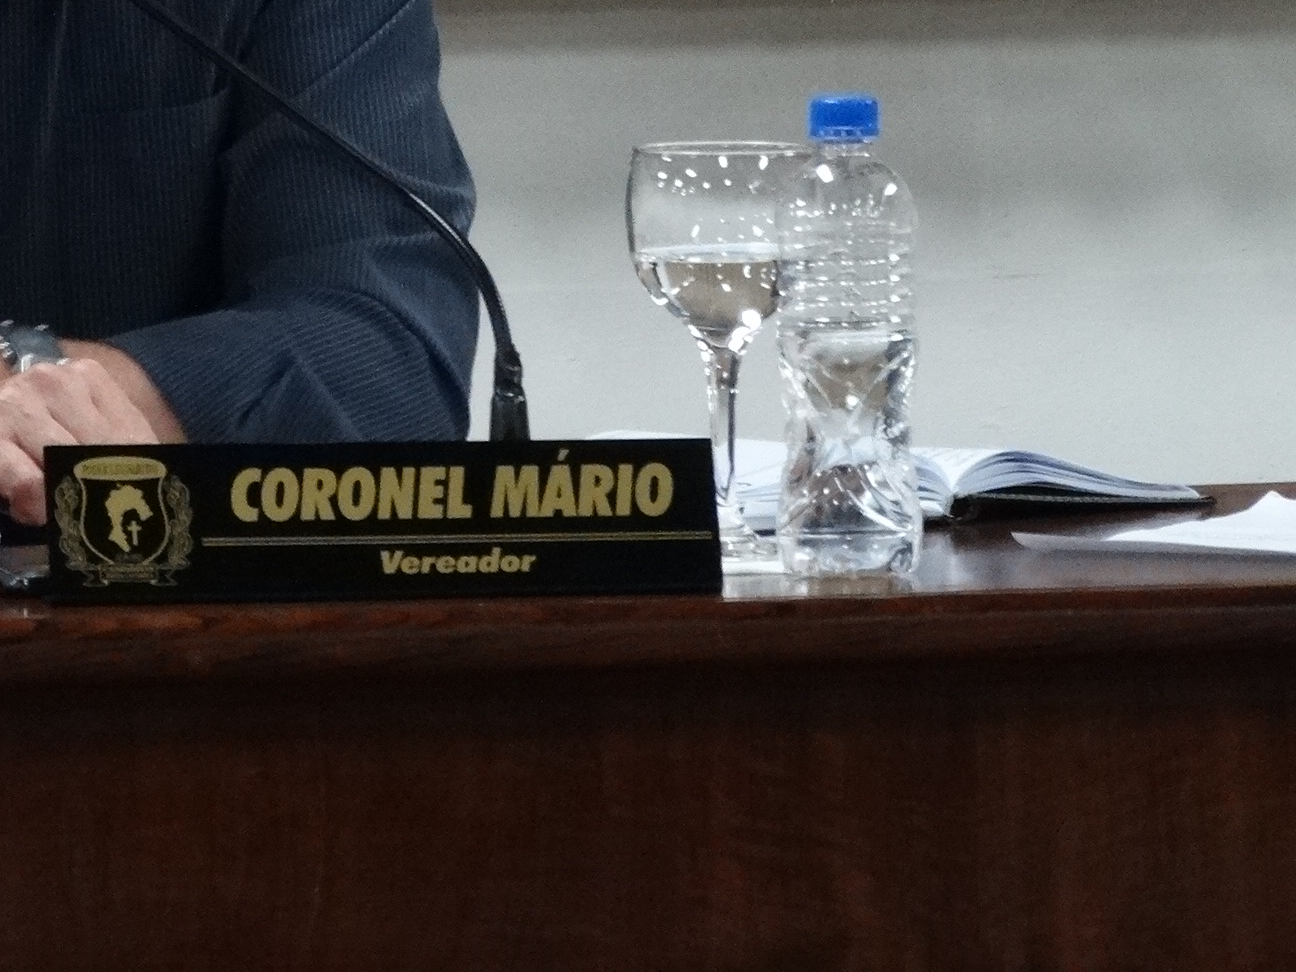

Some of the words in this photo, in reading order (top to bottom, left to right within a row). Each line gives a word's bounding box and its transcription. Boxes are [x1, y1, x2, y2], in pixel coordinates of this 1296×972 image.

[229, 465, 473, 524] CORONEL
[489, 448, 675, 521] MÁRIO
[380, 547, 537, 576] Vereador
